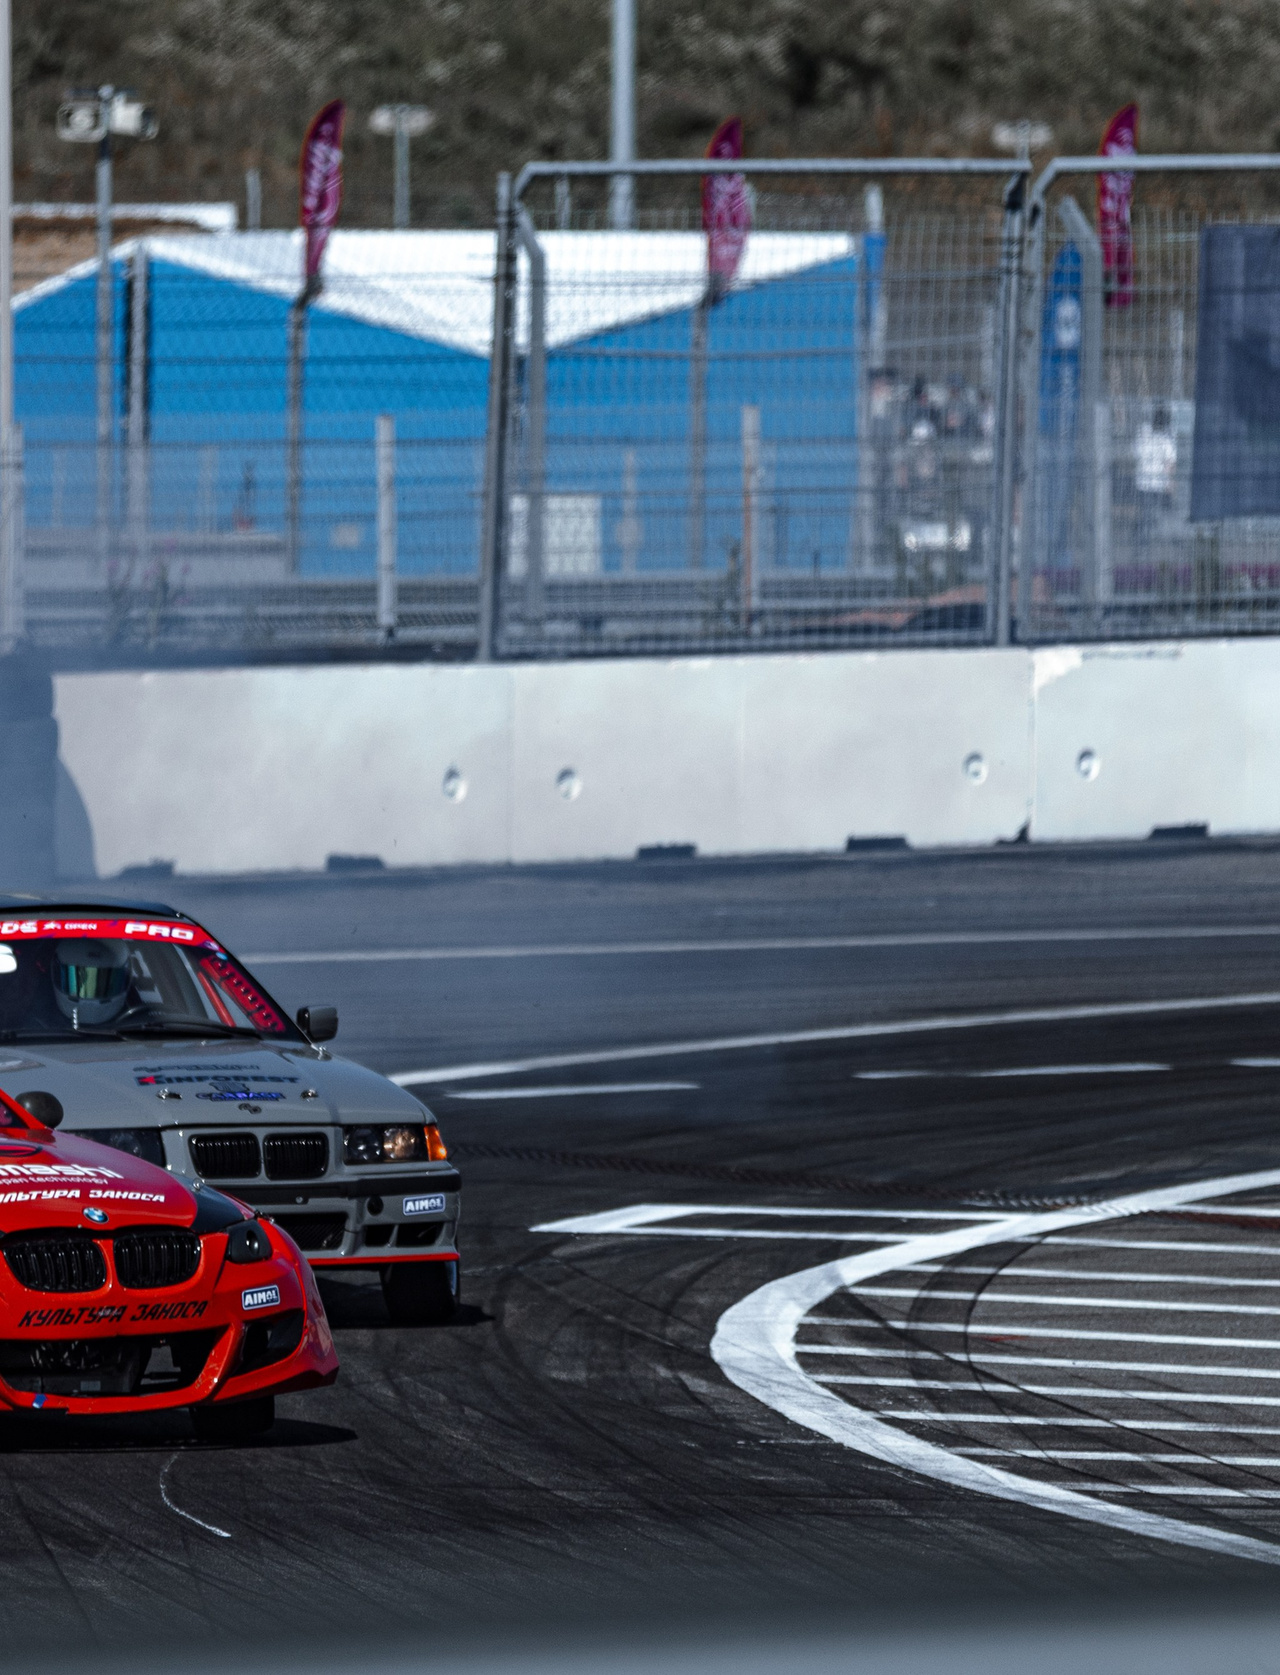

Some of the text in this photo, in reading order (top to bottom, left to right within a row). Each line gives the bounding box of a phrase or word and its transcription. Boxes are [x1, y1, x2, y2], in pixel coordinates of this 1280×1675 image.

[64, 923, 97, 931] OPEN
[125, 922, 194, 940] PRO
[89, 1189, 165, 1203] ЗАНОСА
[405, 1198, 442, 1212] AIMOL
[244, 1289, 277, 1306] AIMOL
[18, 1300, 209, 1328] КУЛЬТУРА ЗАНОСА
